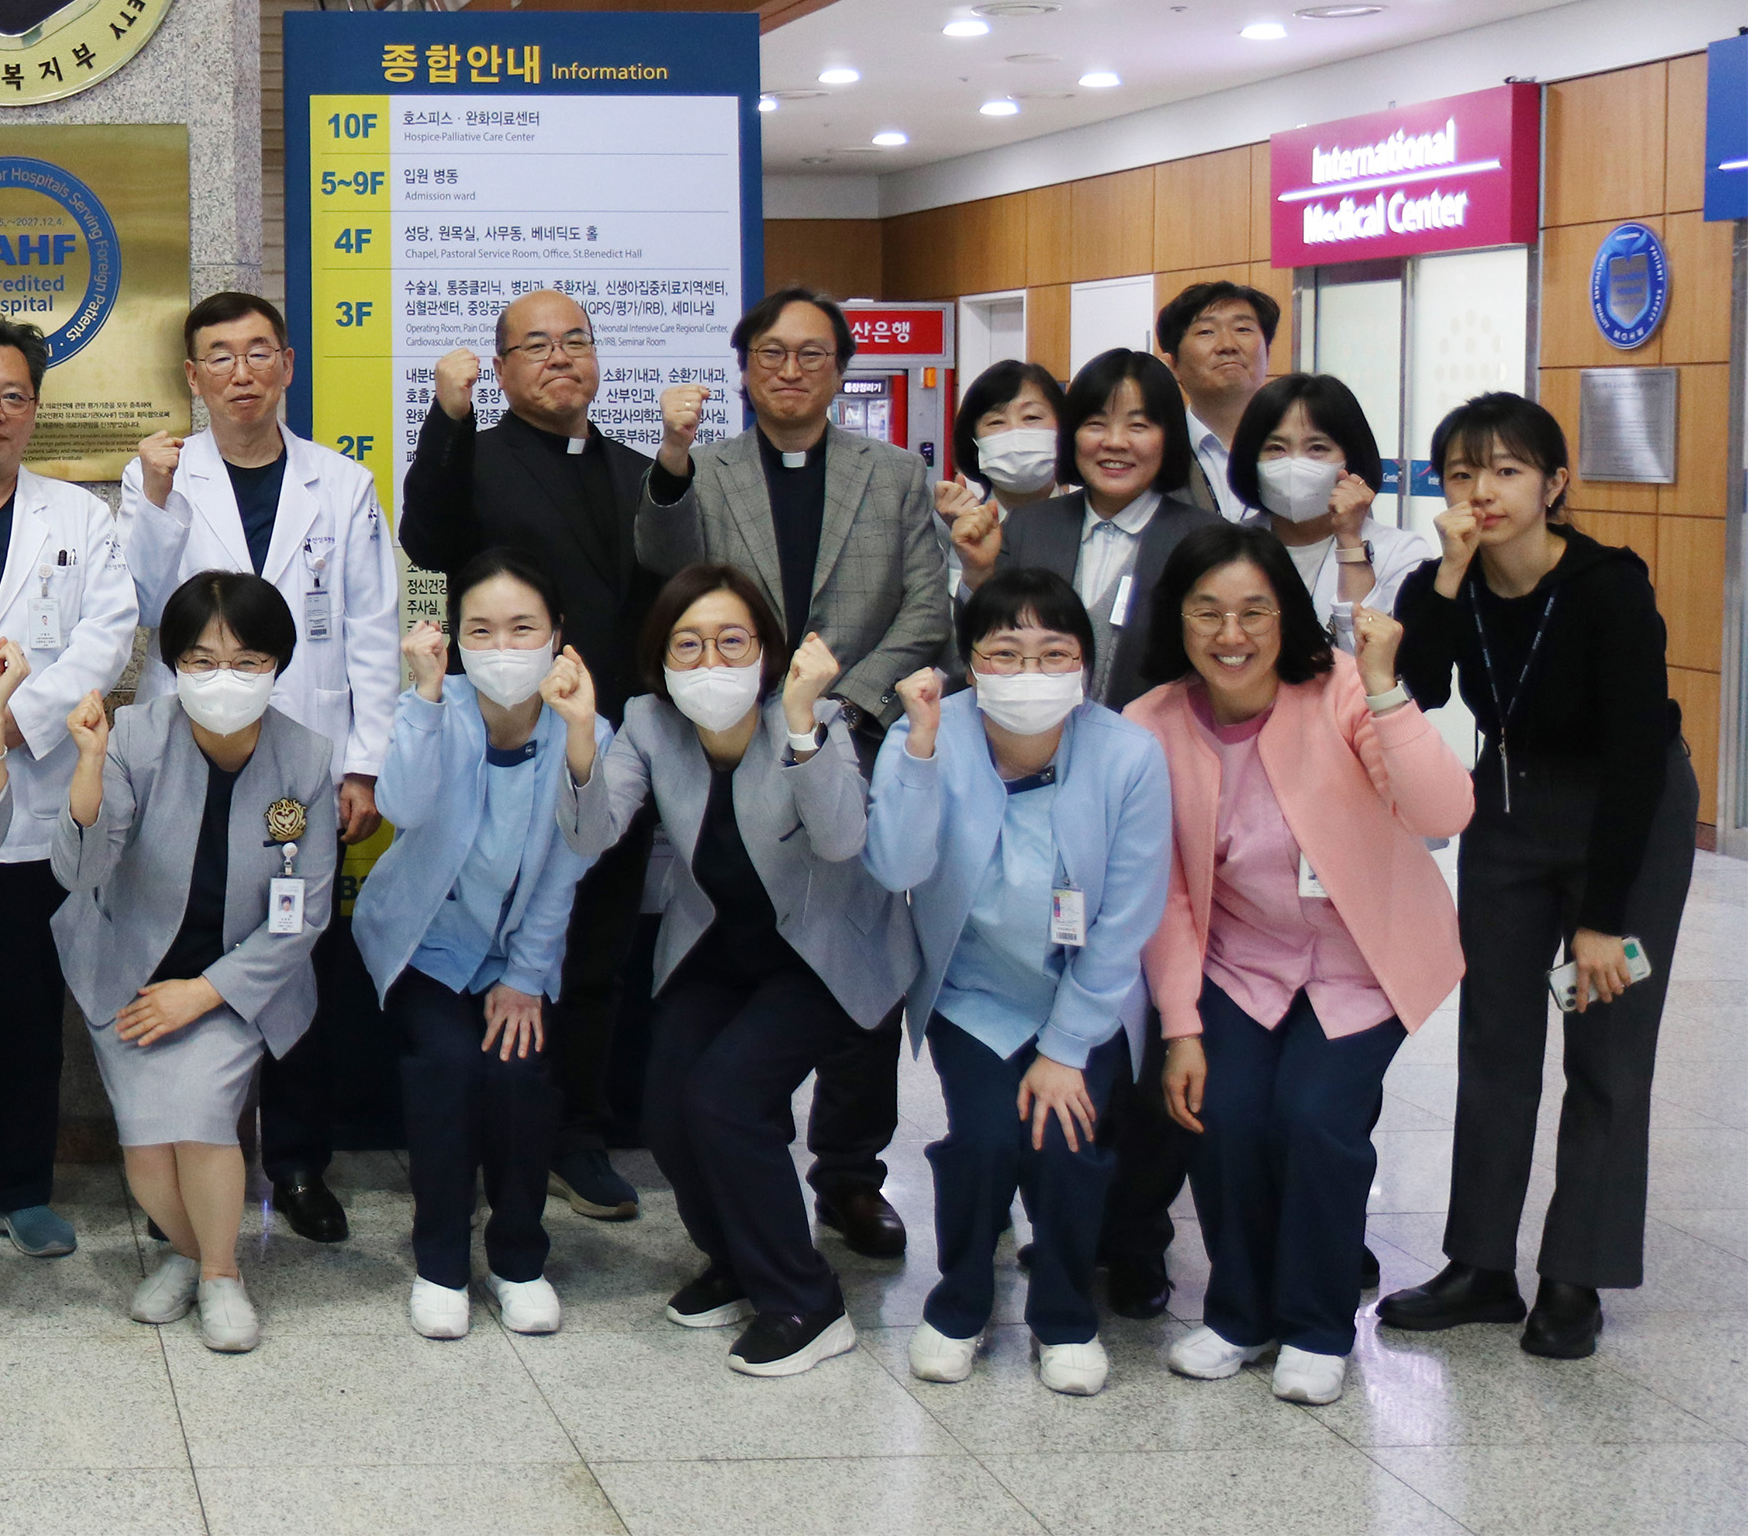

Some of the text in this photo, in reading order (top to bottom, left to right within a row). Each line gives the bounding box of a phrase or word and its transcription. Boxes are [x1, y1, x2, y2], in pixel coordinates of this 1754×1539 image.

[381, 44, 668, 84] 종합안내 Information
[328, 113, 378, 139] 10F
[403, 110, 540, 127] 호스피스 완화의료센터
[483, 131, 504, 143] Care
[505, 131, 535, 143] Center
[1312, 115, 1456, 184] International
[11, 168, 70, 198] Hospitals
[321, 170, 385, 196] 5~9F
[403, 168, 459, 184] 입원 병동
[405, 191, 476, 201] Admission ward
[68, 192, 103, 239] Serving
[1303, 187, 1468, 244] Medical Center
[334, 228, 372, 254] 4F
[404, 225, 598, 242] 성당, 원목실, 사무동, 베네딕도 홀
[405, 249, 642, 260] Chapel, Pastoral Service Room, Office, St.Benedict Hall
[94, 239, 109, 295] Foreign
[404, 280, 441, 296] 수술실,
[447, 280, 505, 296] 통증클리닉,
[65, 294, 106, 342] Patients
[335, 301, 373, 327] 3F
[405, 300, 715, 316] 심혈관센터, 세미나실
[851, 320, 911, 343] 산은행
[603, 368, 729, 383] 소화기내과, 순환기내과,
[477, 388, 655, 404] 종양 산부인과,
[337, 435, 374, 461] 2F
[406, 599, 441, 615] 주사실,
